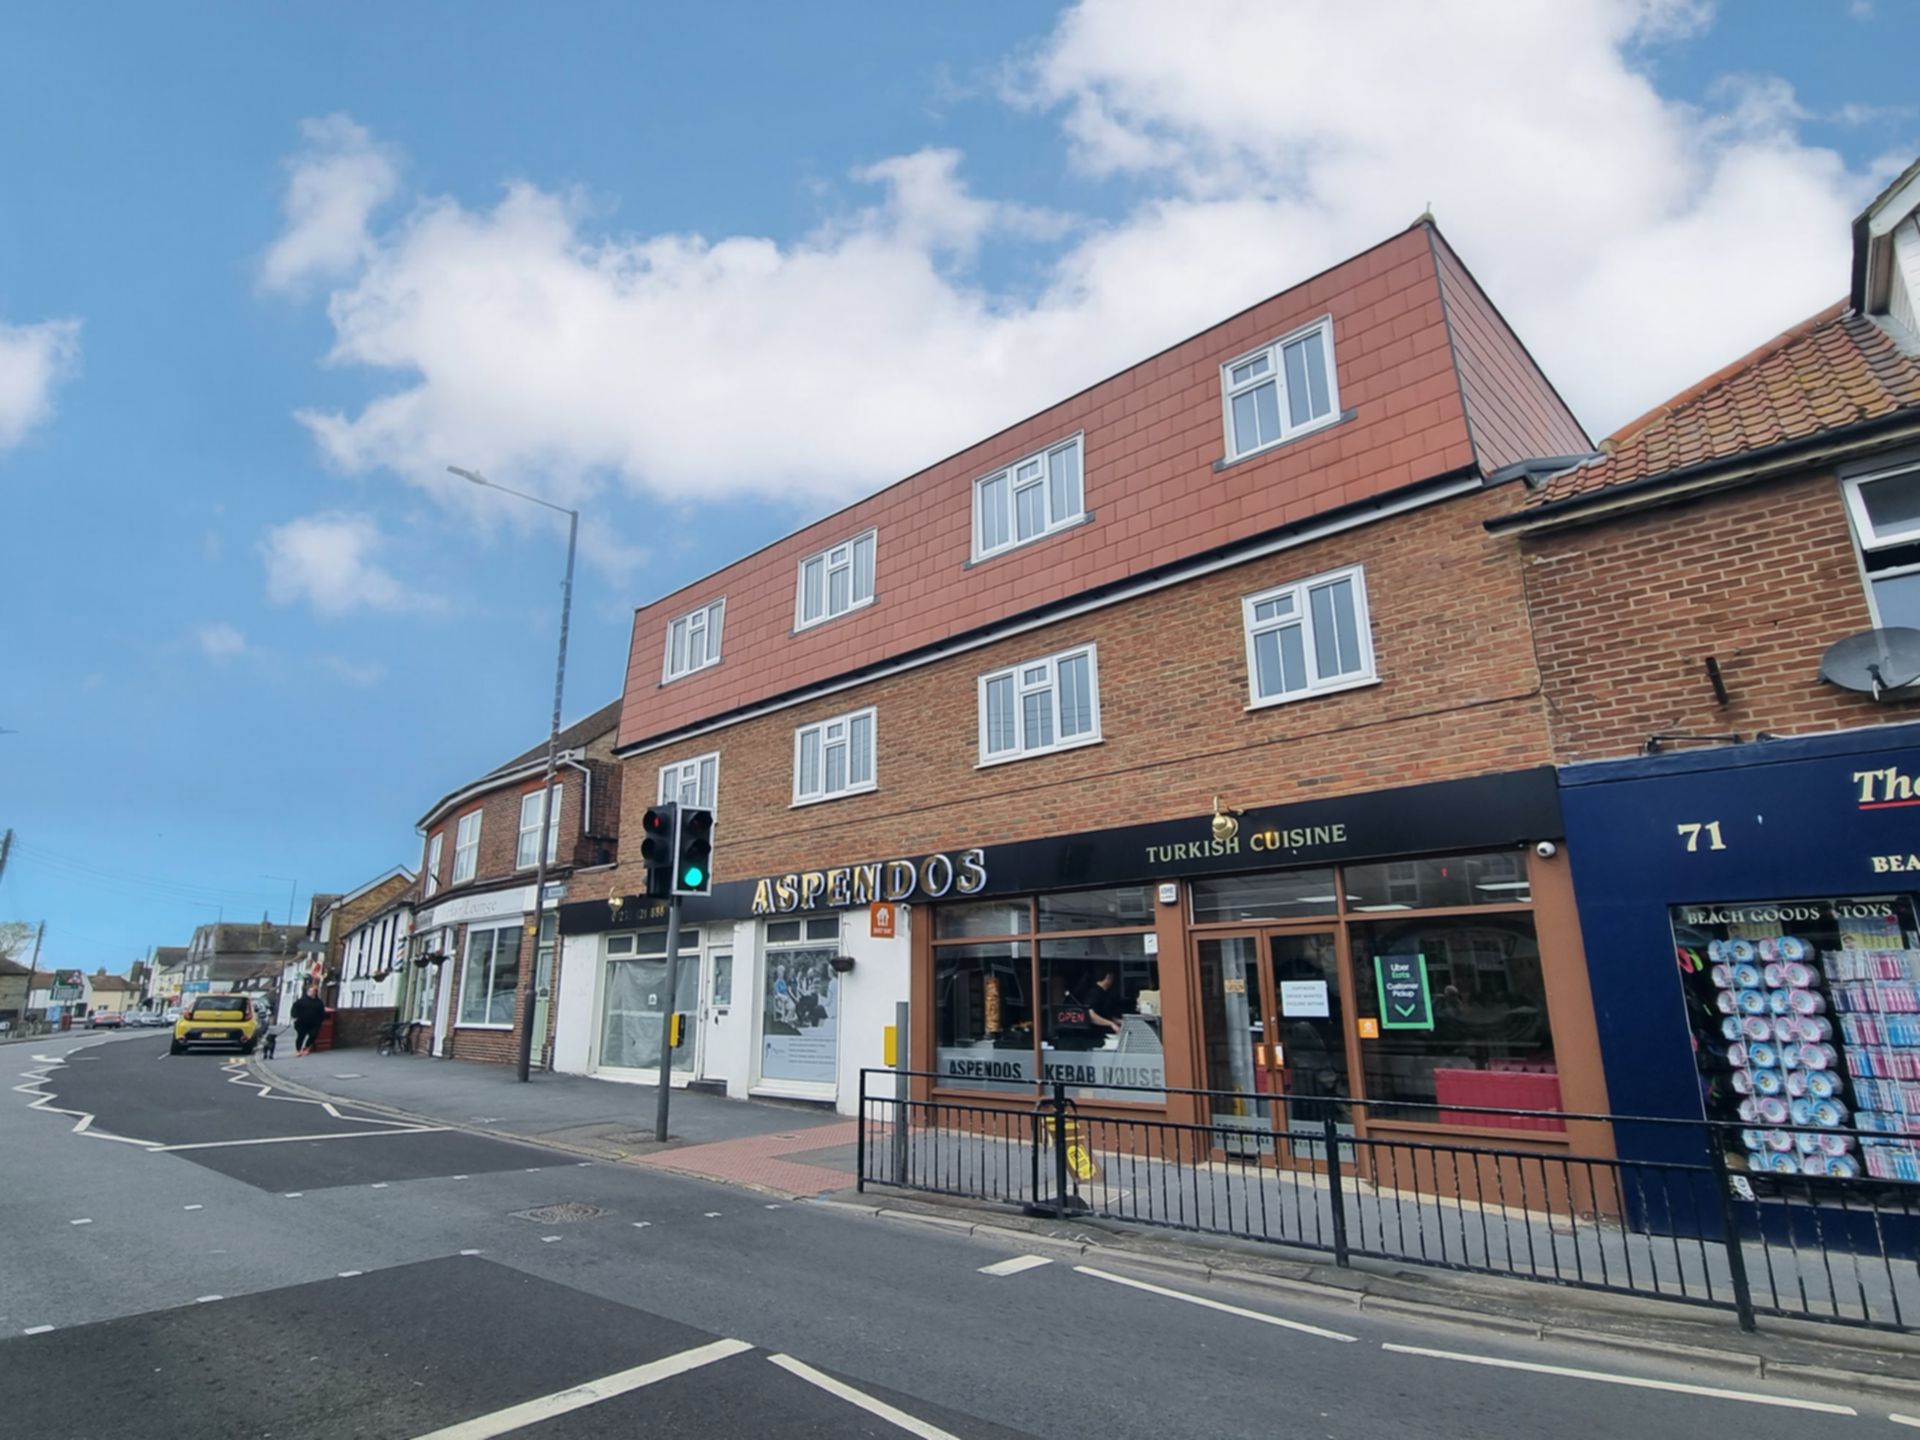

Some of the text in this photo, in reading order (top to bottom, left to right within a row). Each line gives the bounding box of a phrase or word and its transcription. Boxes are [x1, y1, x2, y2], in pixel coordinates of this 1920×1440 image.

[1146, 824, 1347, 863] TURKISH CUISINE
[1677, 821, 1726, 851] 71
[752, 848, 987, 914] ASPENDOS
[1688, 903, 1893, 925] BEACH GOODS TOYS
[1390, 963, 1409, 971] Uber
[1392, 990, 1415, 998] Pickup
[1057, 1011, 1085, 1023] OPEN
[950, 1059, 1162, 1088] ASPENDOS KEBAB HOUSE
